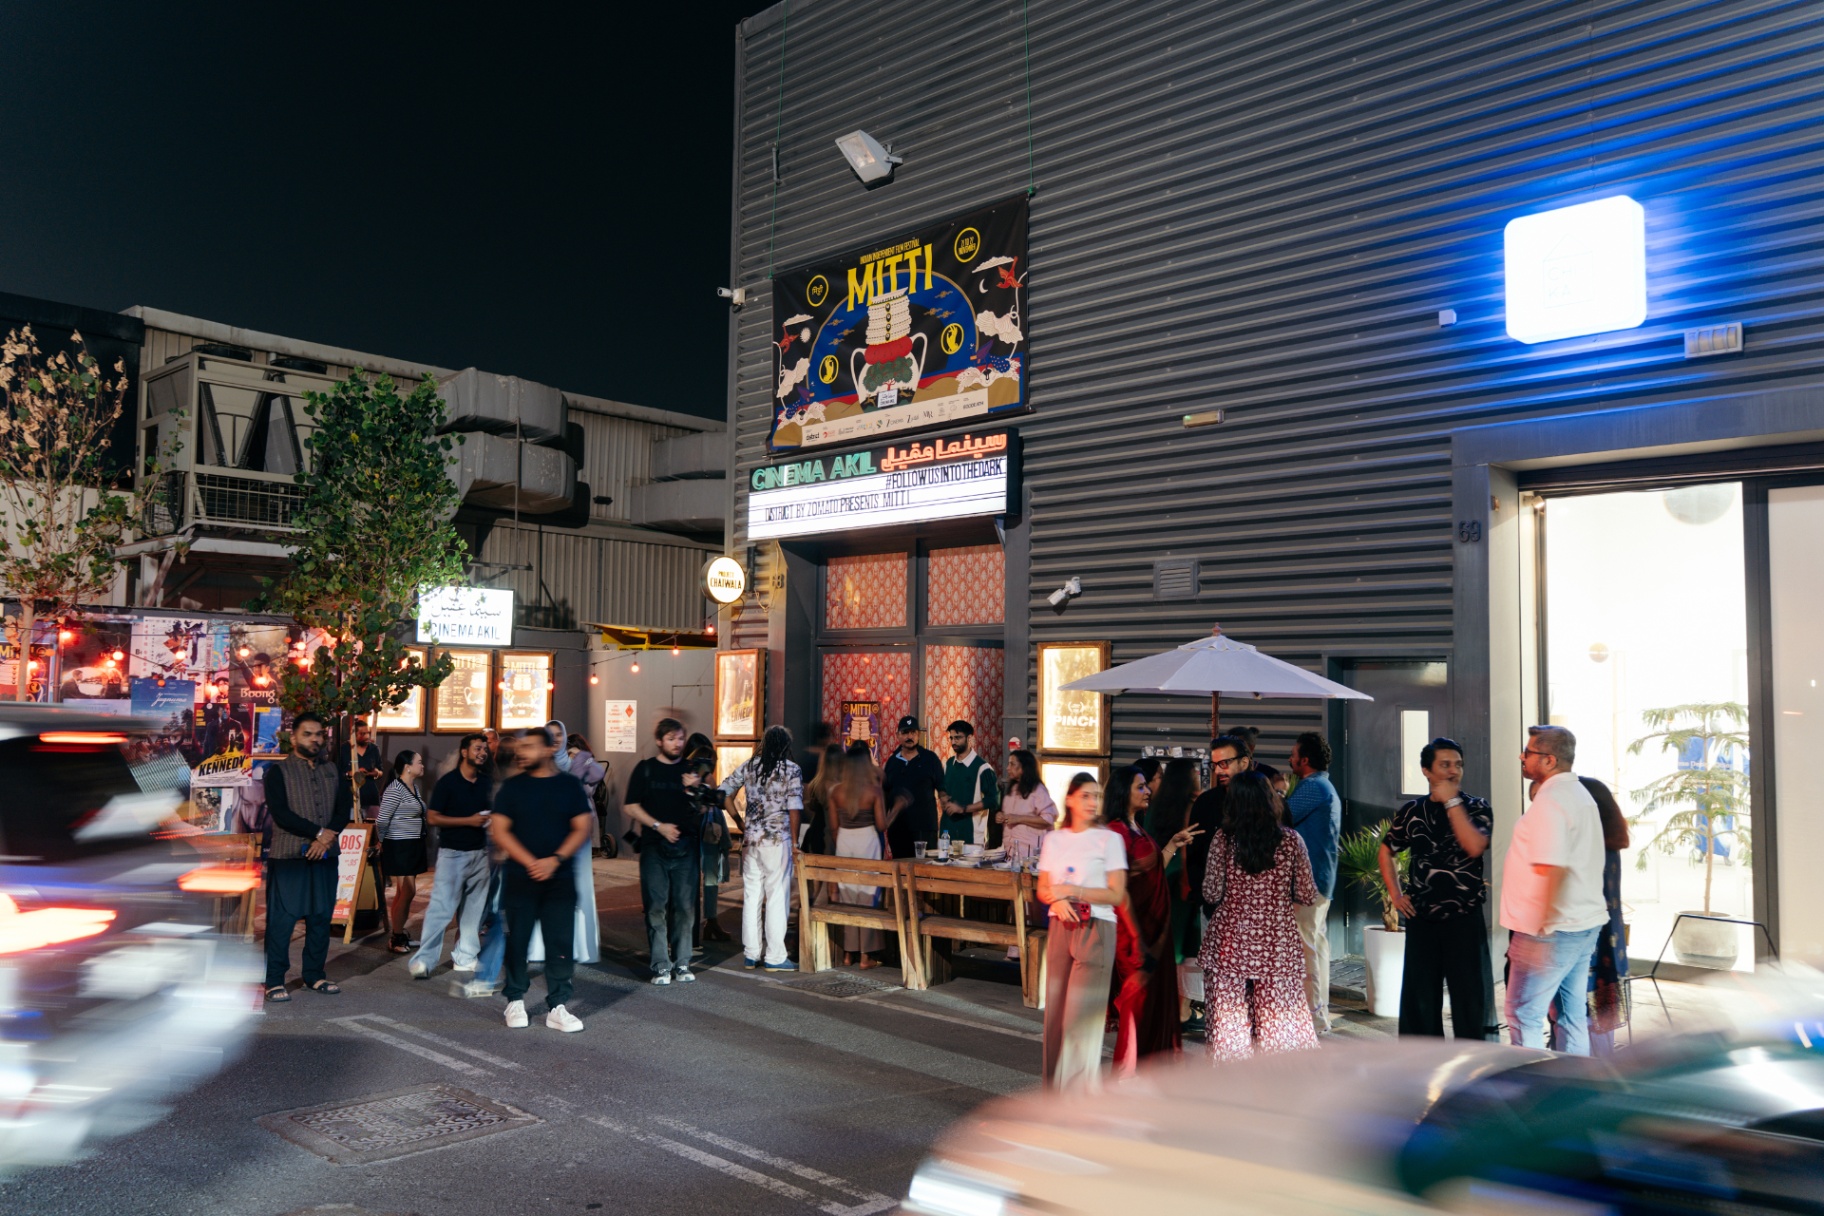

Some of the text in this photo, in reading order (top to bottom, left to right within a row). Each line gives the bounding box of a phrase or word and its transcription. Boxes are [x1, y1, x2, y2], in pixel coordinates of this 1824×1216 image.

[872, 246, 895, 260] INDEPENDENT
[895, 243, 904, 255] FILM
[903, 238, 920, 251] FESTIVAL
[846, 243, 933, 312] MITTI
[881, 434, 1007, 472] سينما عقيل
[751, 451, 877, 490] CINEMA AKIL
[765, 489, 910, 522] DISTRICT BY ZOMATO PRESENTS MITTI
[1459, 520, 1481, 543] 69
[710, 577, 742, 589] CHAIWALA
[430, 622, 500, 640] CINEMA AKIL
[850, 703, 871, 716] MITTI
[1054, 715, 1099, 727] PINCH
[198, 754, 247, 777] KENNEDY
